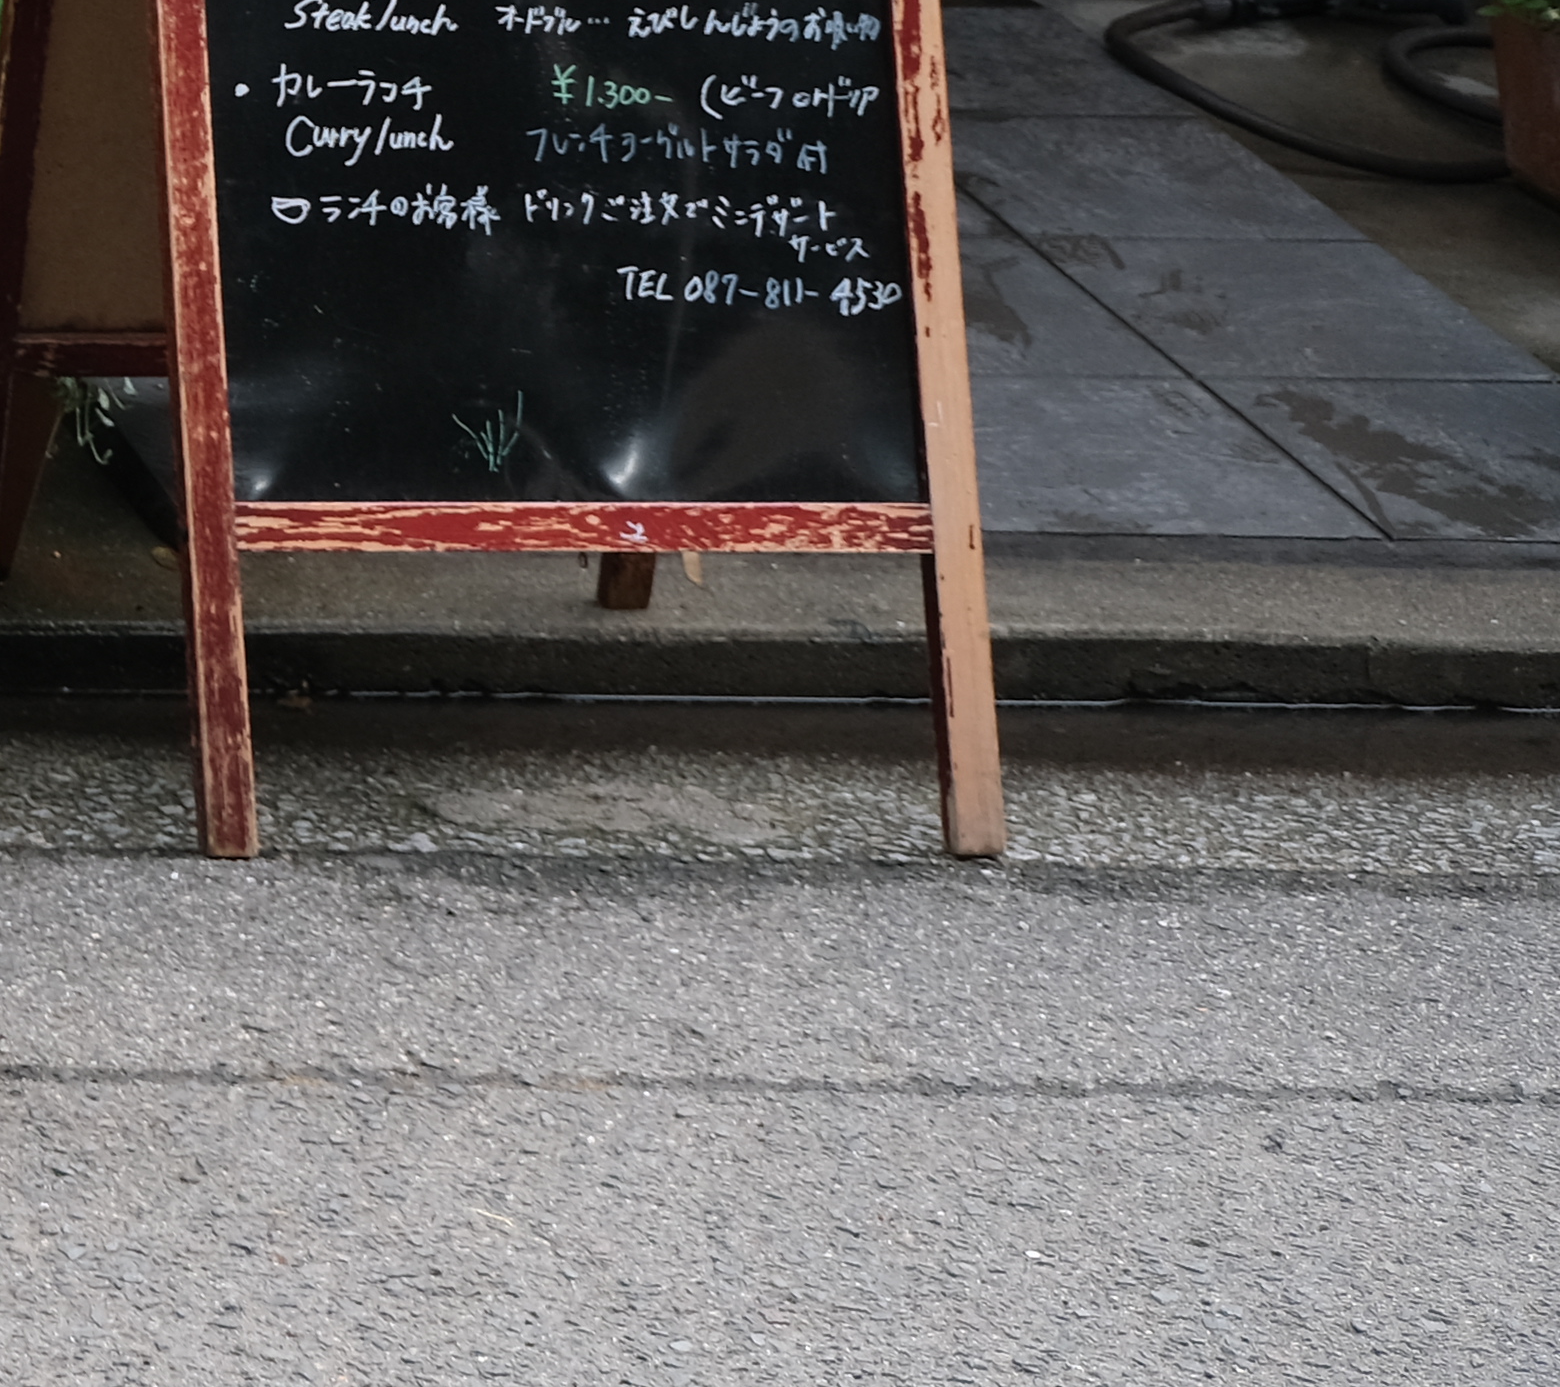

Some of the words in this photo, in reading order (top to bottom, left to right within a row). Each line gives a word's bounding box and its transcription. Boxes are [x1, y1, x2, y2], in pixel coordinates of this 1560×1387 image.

[271, 62, 433, 111] カレーランチ
[285, 114, 372, 167] Curry
[374, 112, 455, 156] lunch
[787, 234, 871, 263] サービス
[616, 264, 674, 302] TEL
